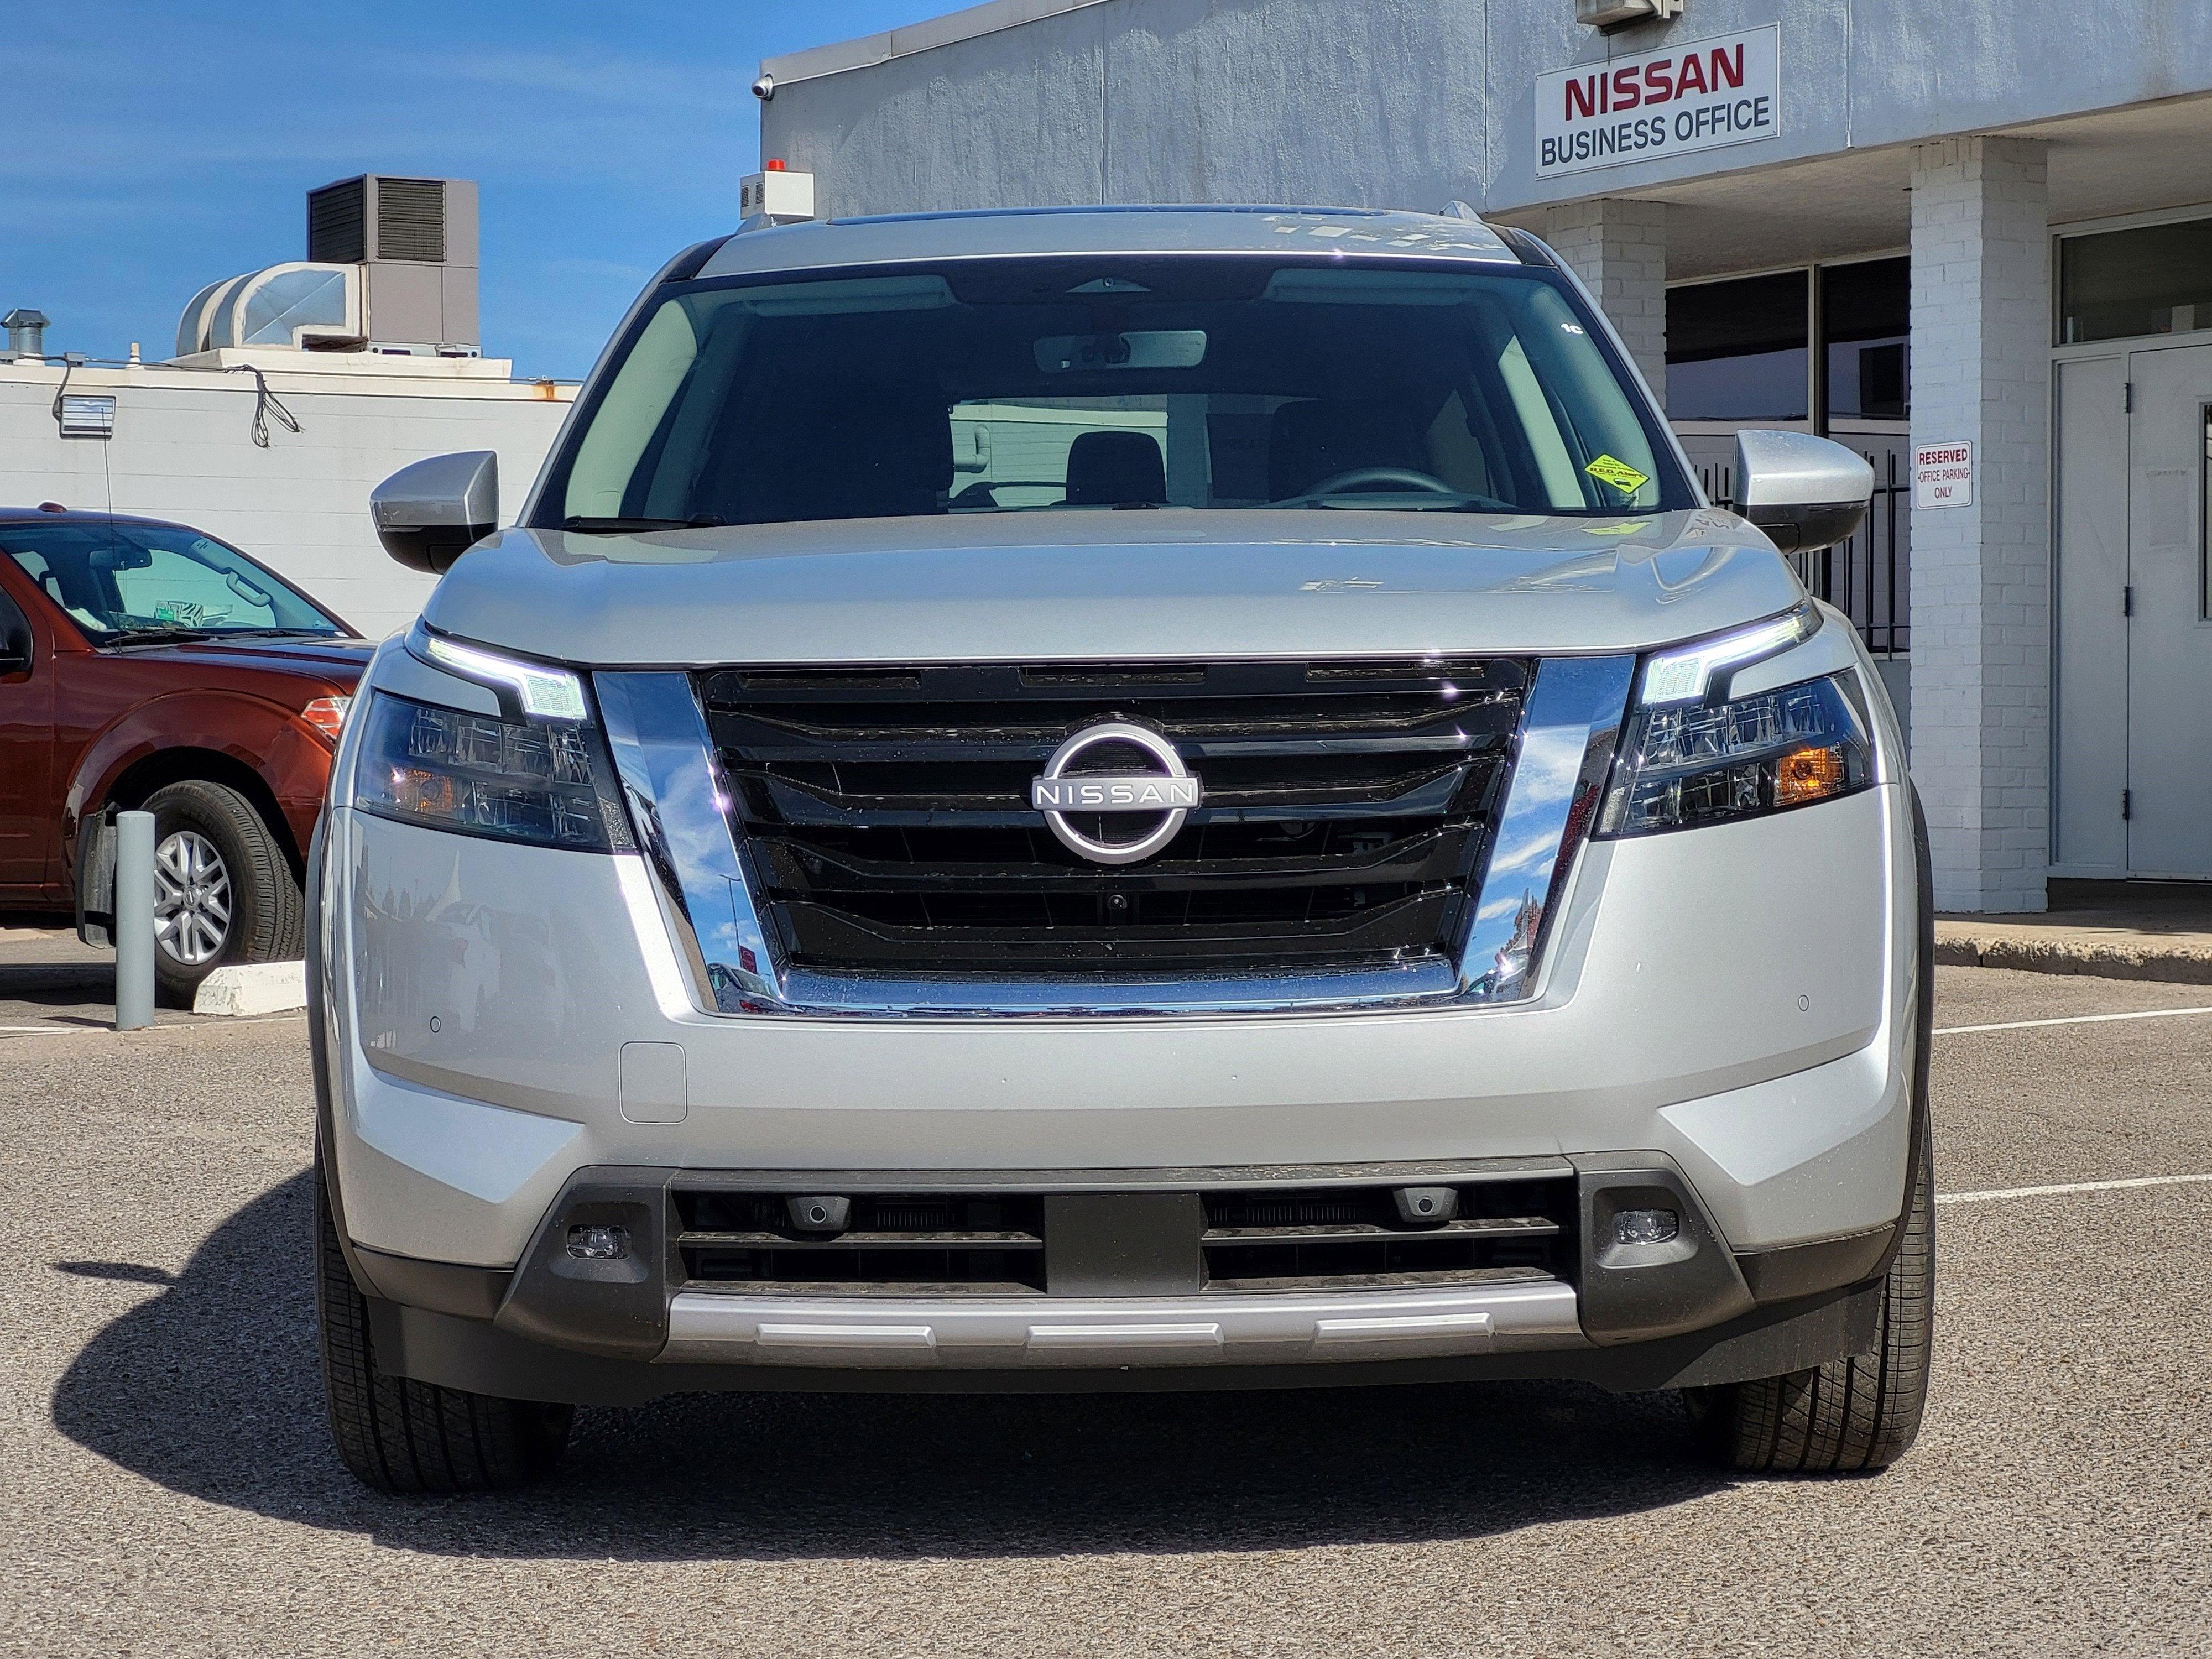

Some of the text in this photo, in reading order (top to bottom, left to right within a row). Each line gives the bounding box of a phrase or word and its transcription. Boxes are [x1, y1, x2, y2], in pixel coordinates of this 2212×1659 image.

[1566, 43, 1744, 121] NISSAN
[1542, 96, 1770, 166] BUSINESS OFFICE
[1919, 448, 1968, 466] RESERVED
[1934, 486, 1953, 499] ONLY
[1036, 784, 1192, 805] NISSAN
